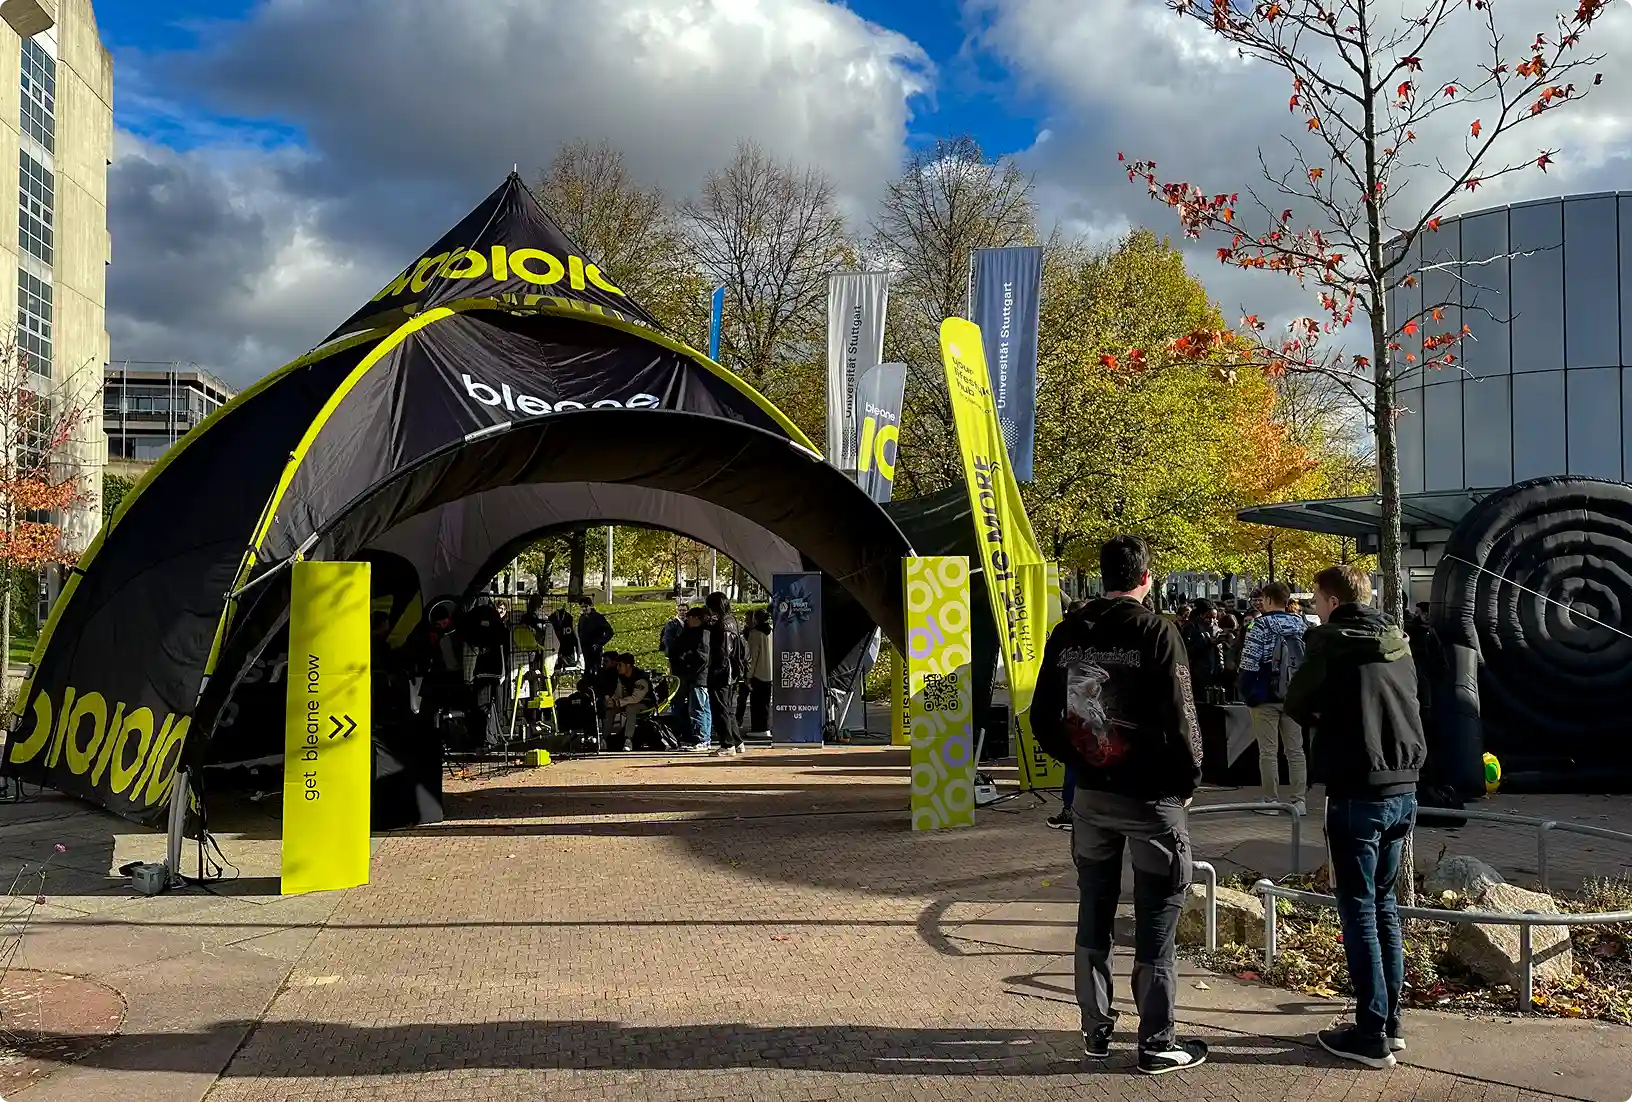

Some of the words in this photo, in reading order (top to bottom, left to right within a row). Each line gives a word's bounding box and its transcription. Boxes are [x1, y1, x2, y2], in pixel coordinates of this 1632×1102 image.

[849, 304, 863, 353] Stuttgart
[1001, 281, 1015, 338] Stuttgart
[846, 360, 857, 419] Universität
[956, 379, 975, 397] hub
[998, 341, 1011, 409] Universität
[866, 401, 896, 421] bleane
[1019, 625, 1036, 662] with
[307, 654, 320, 692] now
[775, 704, 787, 712] GET
[788, 704, 796, 712] TO
[796, 704, 820, 712] KNOW
[301, 700, 319, 761] bleane
[304, 770, 320, 801] get
